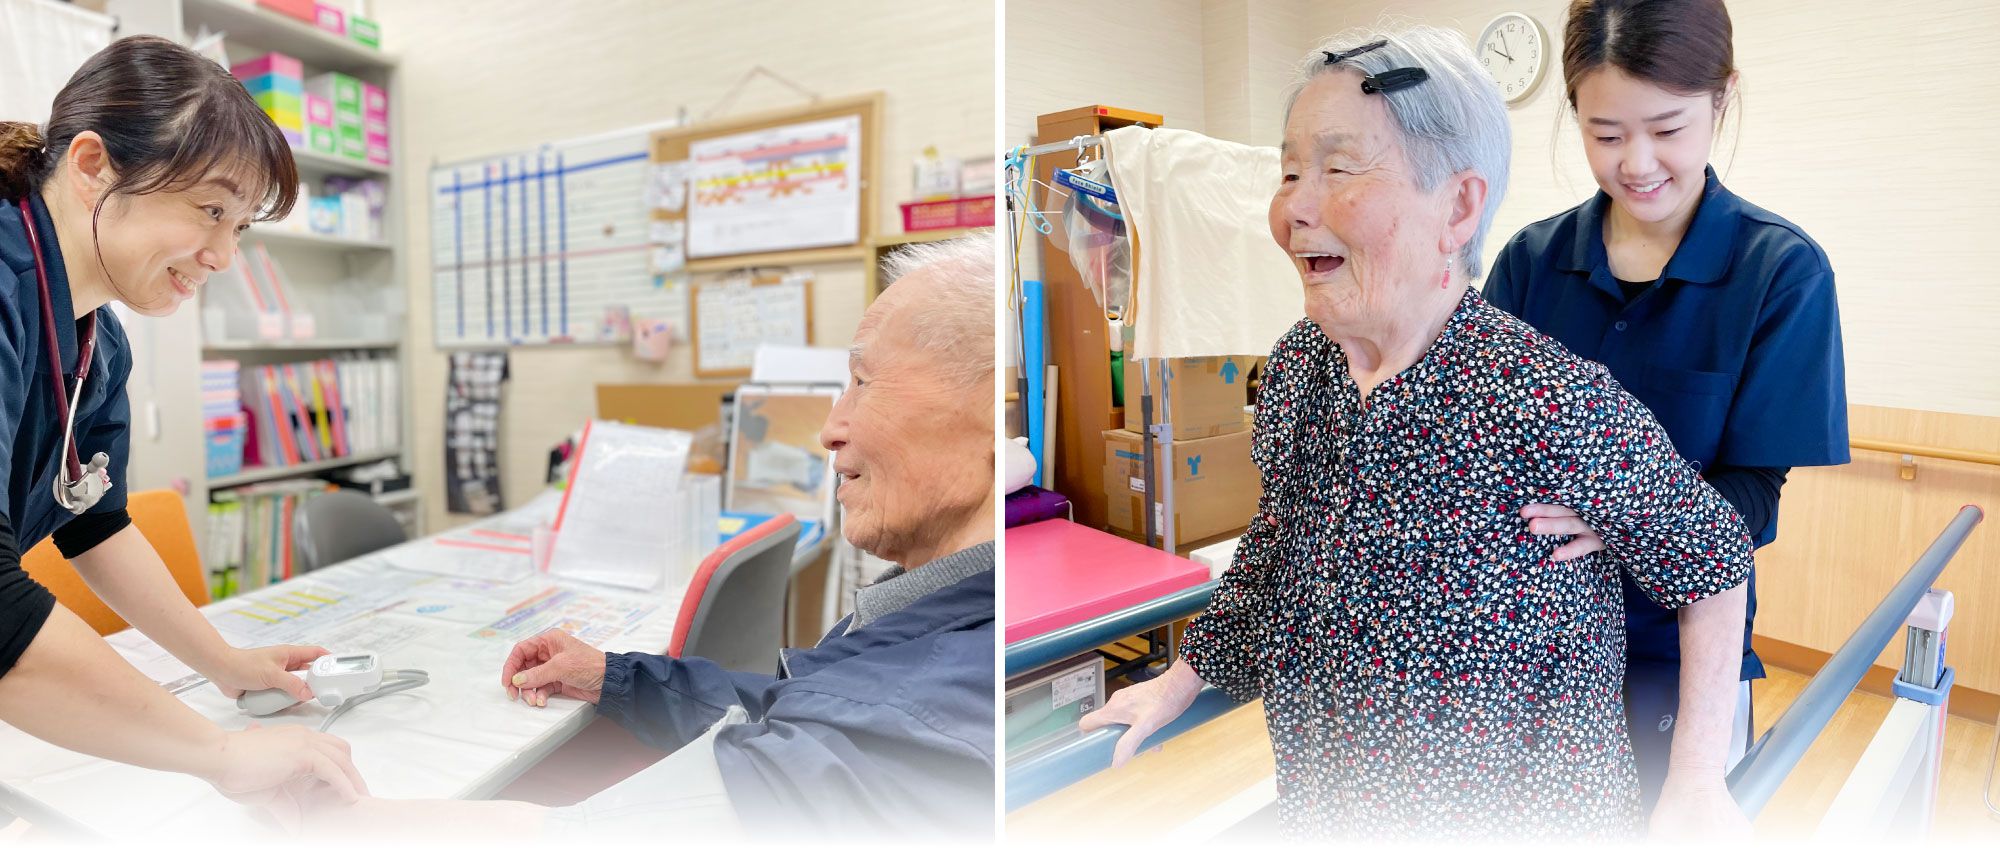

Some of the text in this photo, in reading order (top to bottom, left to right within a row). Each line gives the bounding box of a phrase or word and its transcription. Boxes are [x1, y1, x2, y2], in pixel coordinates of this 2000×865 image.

[1507, 24, 1515, 32] 12
[1528, 35, 1534, 44] 2
[1488, 43, 1496, 51] 10
[1484, 58, 1490, 66] 9
[1528, 66, 1534, 74] 4
[1519, 78, 1524, 86] 5
[1507, 84, 1513, 92] 6
